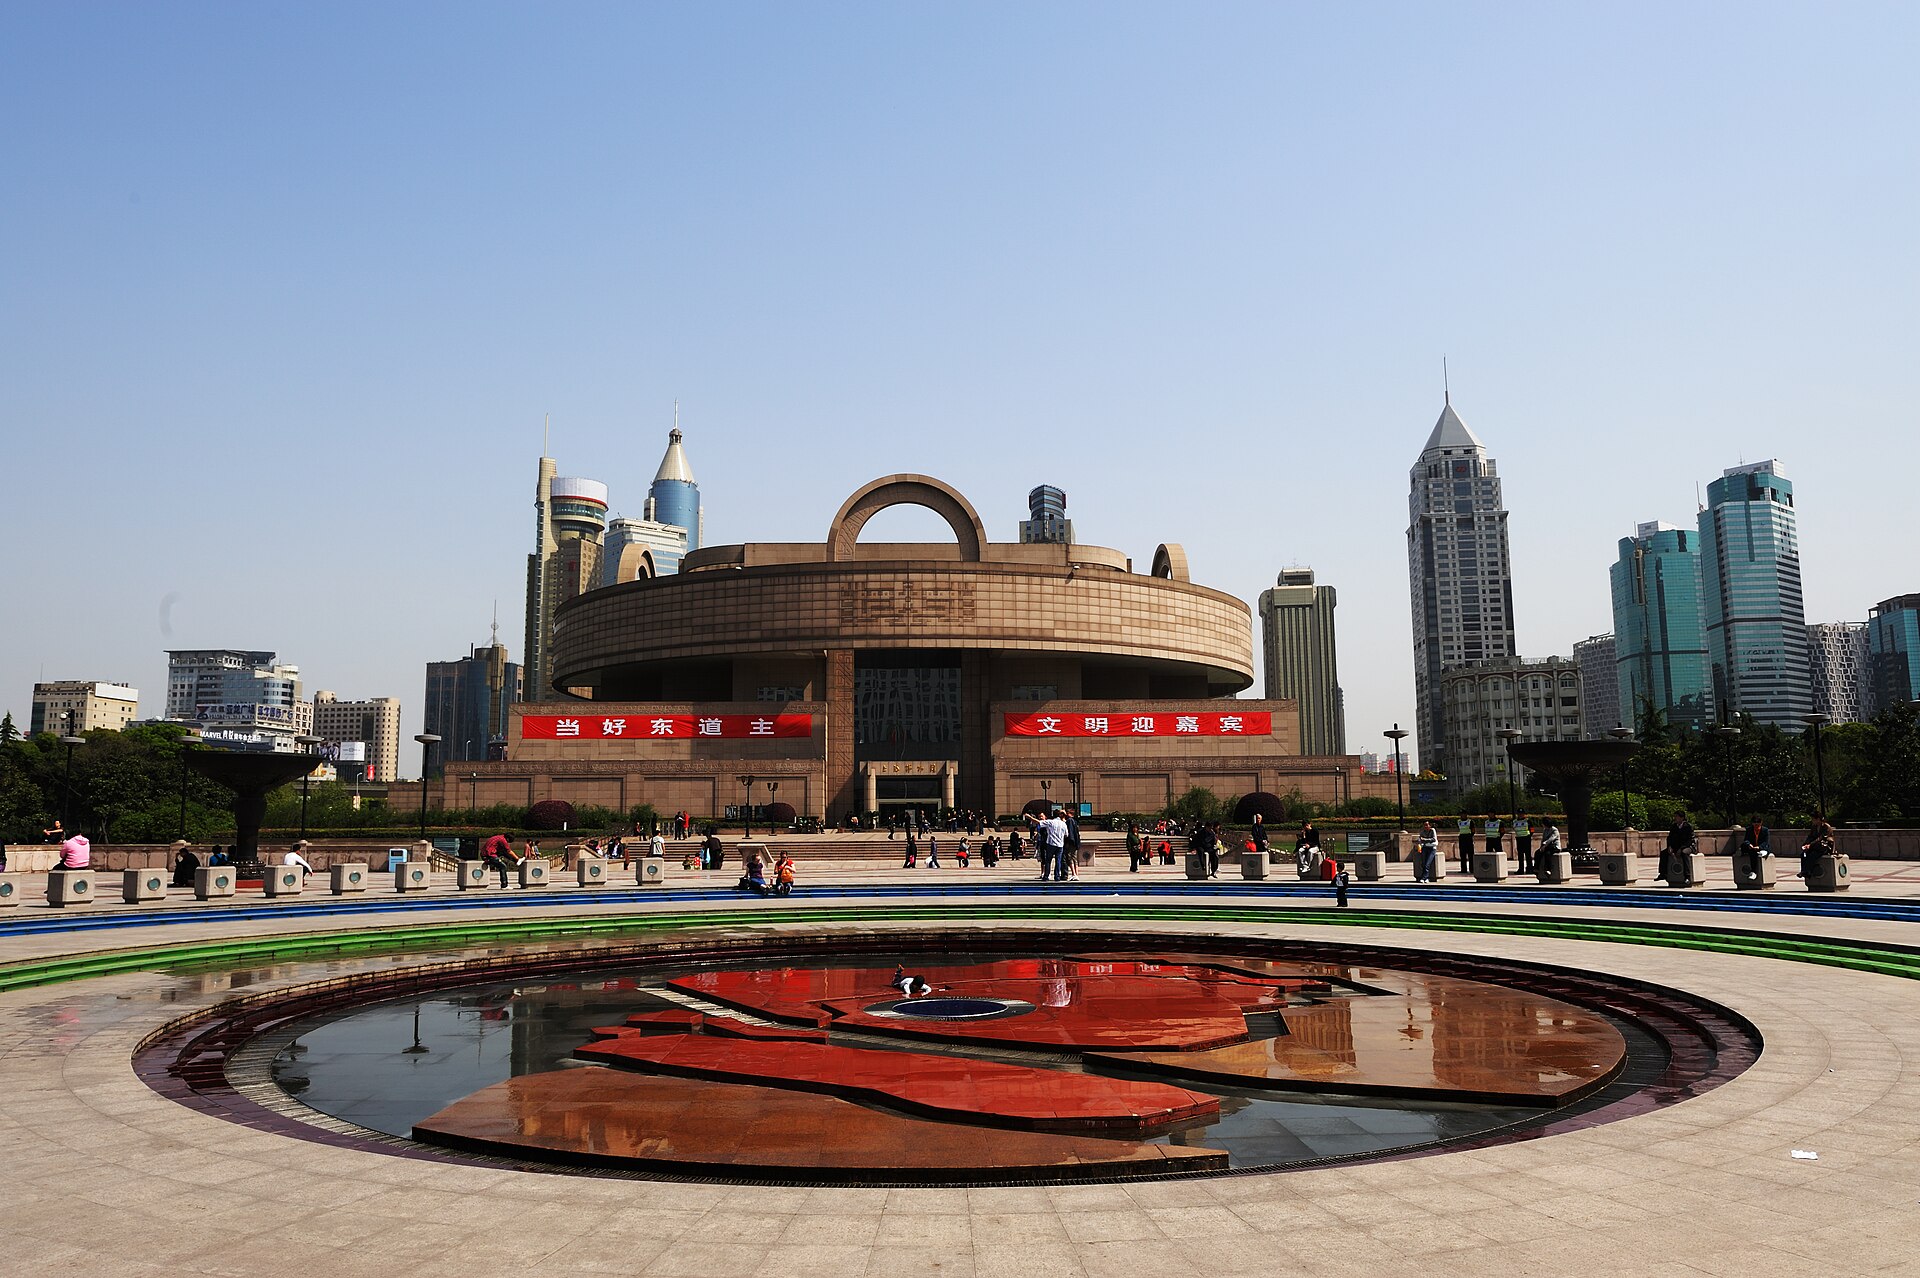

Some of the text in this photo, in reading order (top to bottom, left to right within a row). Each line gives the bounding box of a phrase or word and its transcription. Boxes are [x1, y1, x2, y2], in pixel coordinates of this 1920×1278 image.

[556, 718, 775, 736] 当好东道主
[1037, 716, 1243, 734] 文明迎嘉宾
[200, 731, 222, 739] MARVEL
